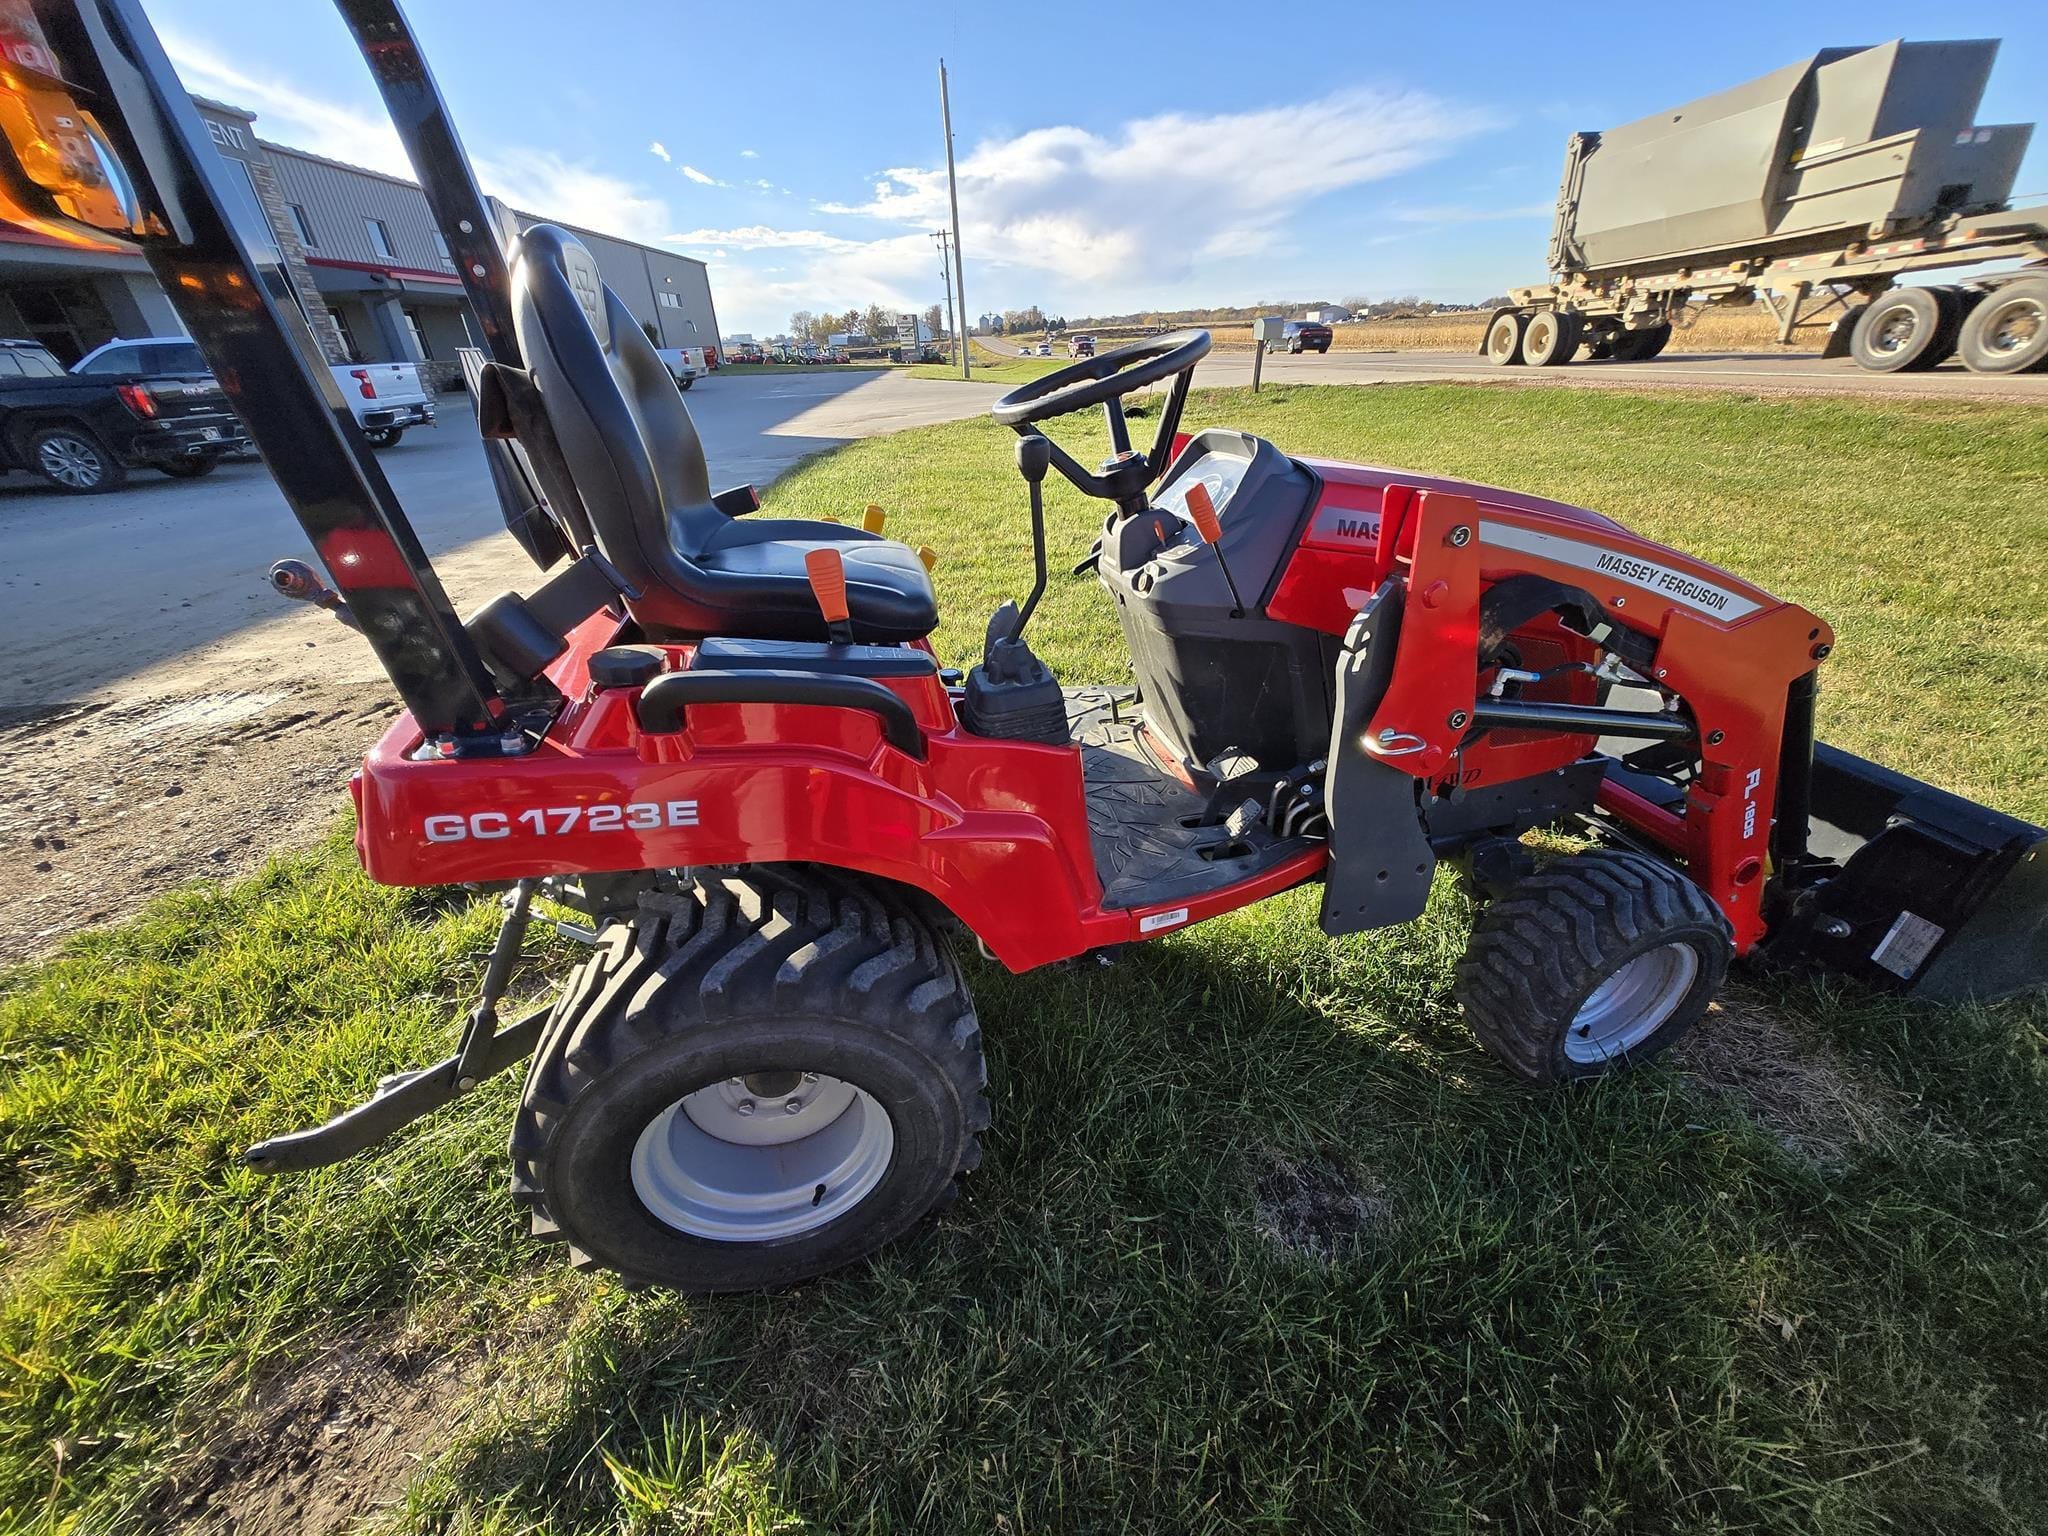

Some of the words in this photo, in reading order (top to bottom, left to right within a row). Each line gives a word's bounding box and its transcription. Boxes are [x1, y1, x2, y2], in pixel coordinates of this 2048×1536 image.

[202, 119, 246, 151] ENT
[1596, 552, 1660, 584] MASSEY
[1657, 572, 1729, 611] FERGUSON
[1744, 768, 1761, 801] FL
[1743, 800, 1757, 839] 1805
